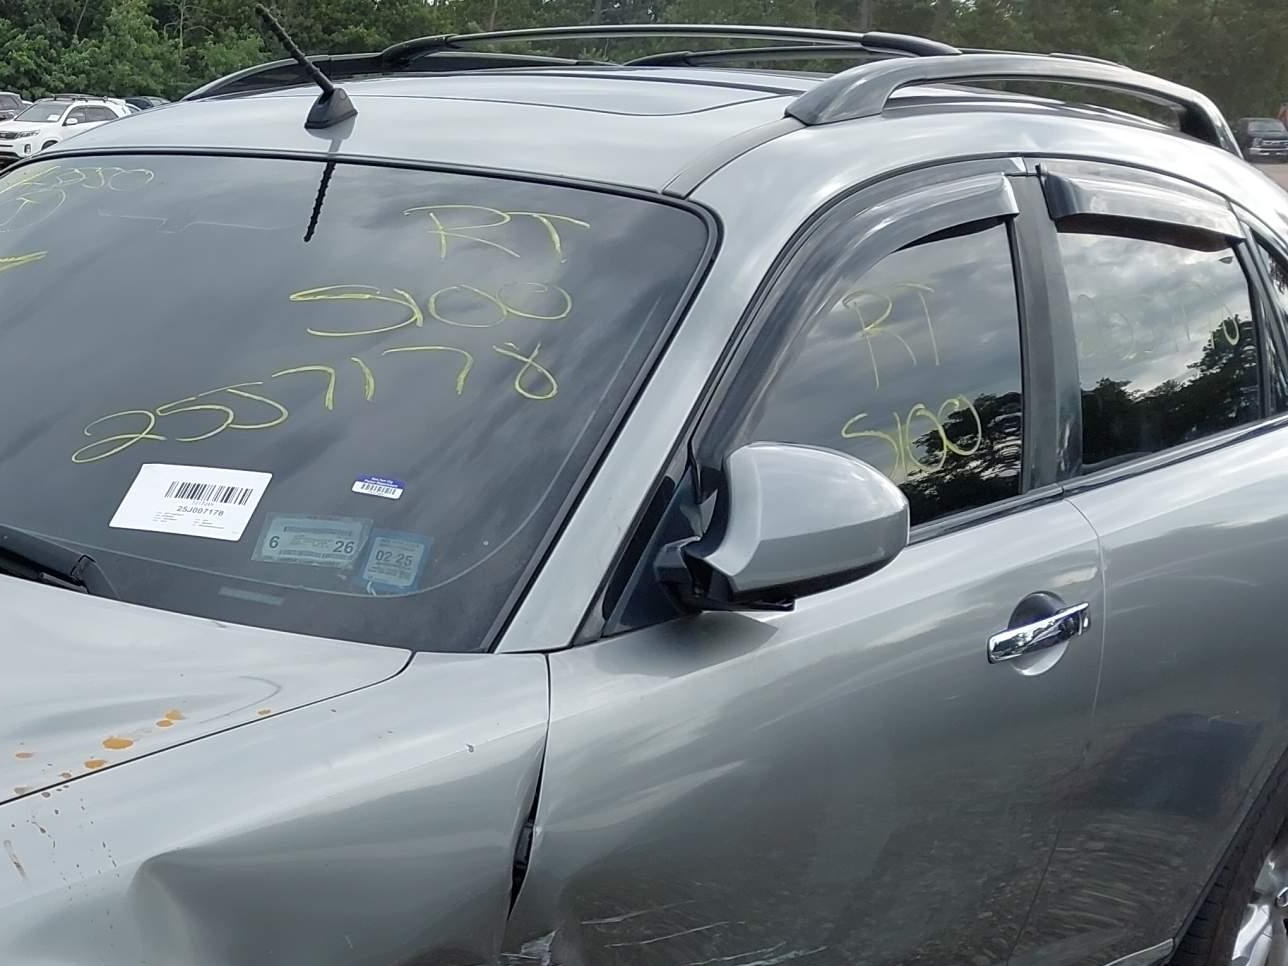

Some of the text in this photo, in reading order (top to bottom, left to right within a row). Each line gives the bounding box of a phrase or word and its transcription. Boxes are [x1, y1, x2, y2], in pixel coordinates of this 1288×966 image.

[841, 282, 940, 391] RT
[268, 535, 355, 554] 6 26
[375, 550, 413, 567] 02 25
